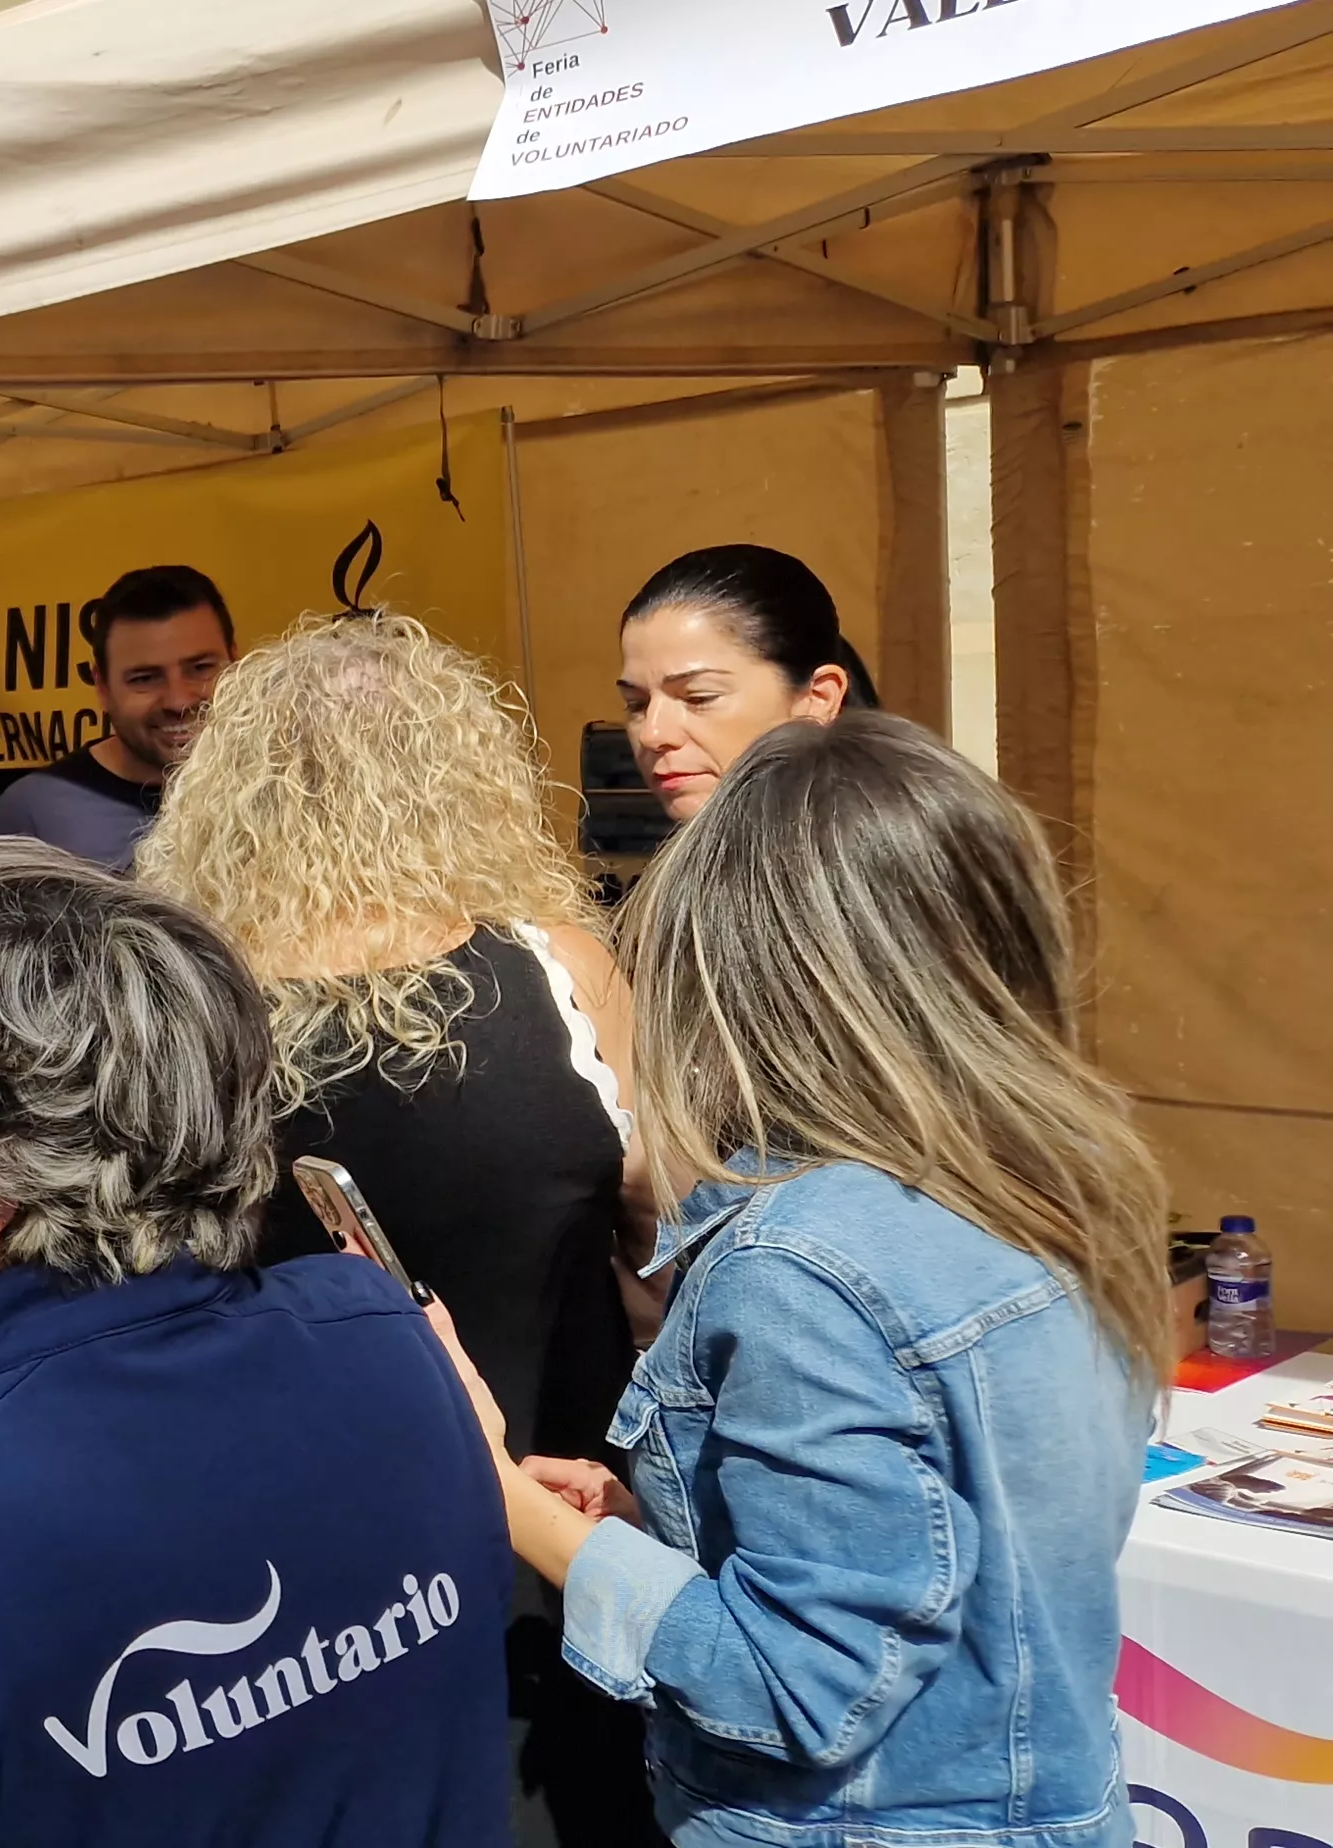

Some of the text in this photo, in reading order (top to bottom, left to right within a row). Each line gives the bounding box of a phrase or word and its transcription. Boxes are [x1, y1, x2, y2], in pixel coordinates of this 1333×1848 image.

[825, 0, 1018, 47] VAL
[532, 52, 580, 79] Feria
[523, 82, 644, 124] ENTIDADES
[530, 85, 553, 102] de
[511, 116, 689, 167] VOLUNTARIADO
[516, 129, 541, 145] de
[43, 1558, 461, 1778] Voluntario
